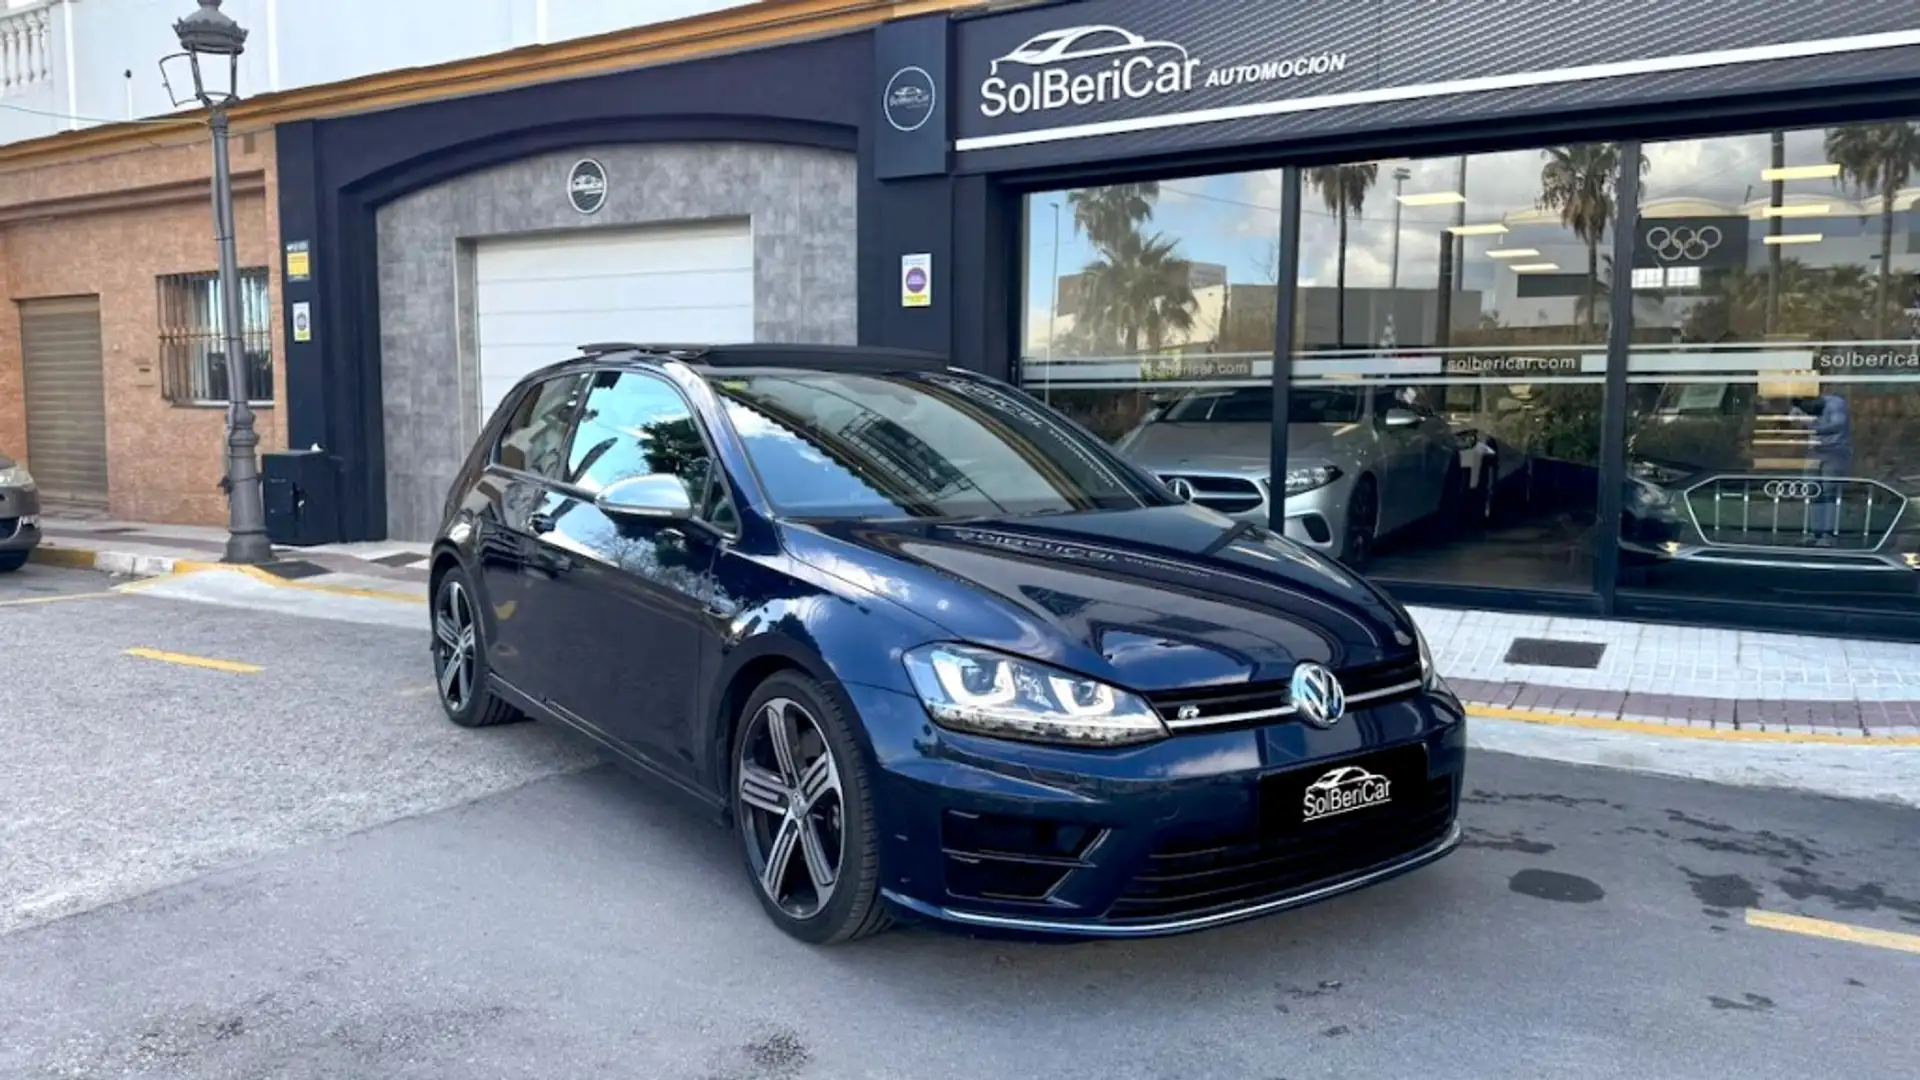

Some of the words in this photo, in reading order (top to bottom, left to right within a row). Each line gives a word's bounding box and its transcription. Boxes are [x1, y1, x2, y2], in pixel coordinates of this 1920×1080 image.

[980, 56, 1200, 117] SolBeriCar
[1204, 52, 1347, 88] AUTOMOCIÓN
[1447, 356, 1576, 371] solbericar.com
